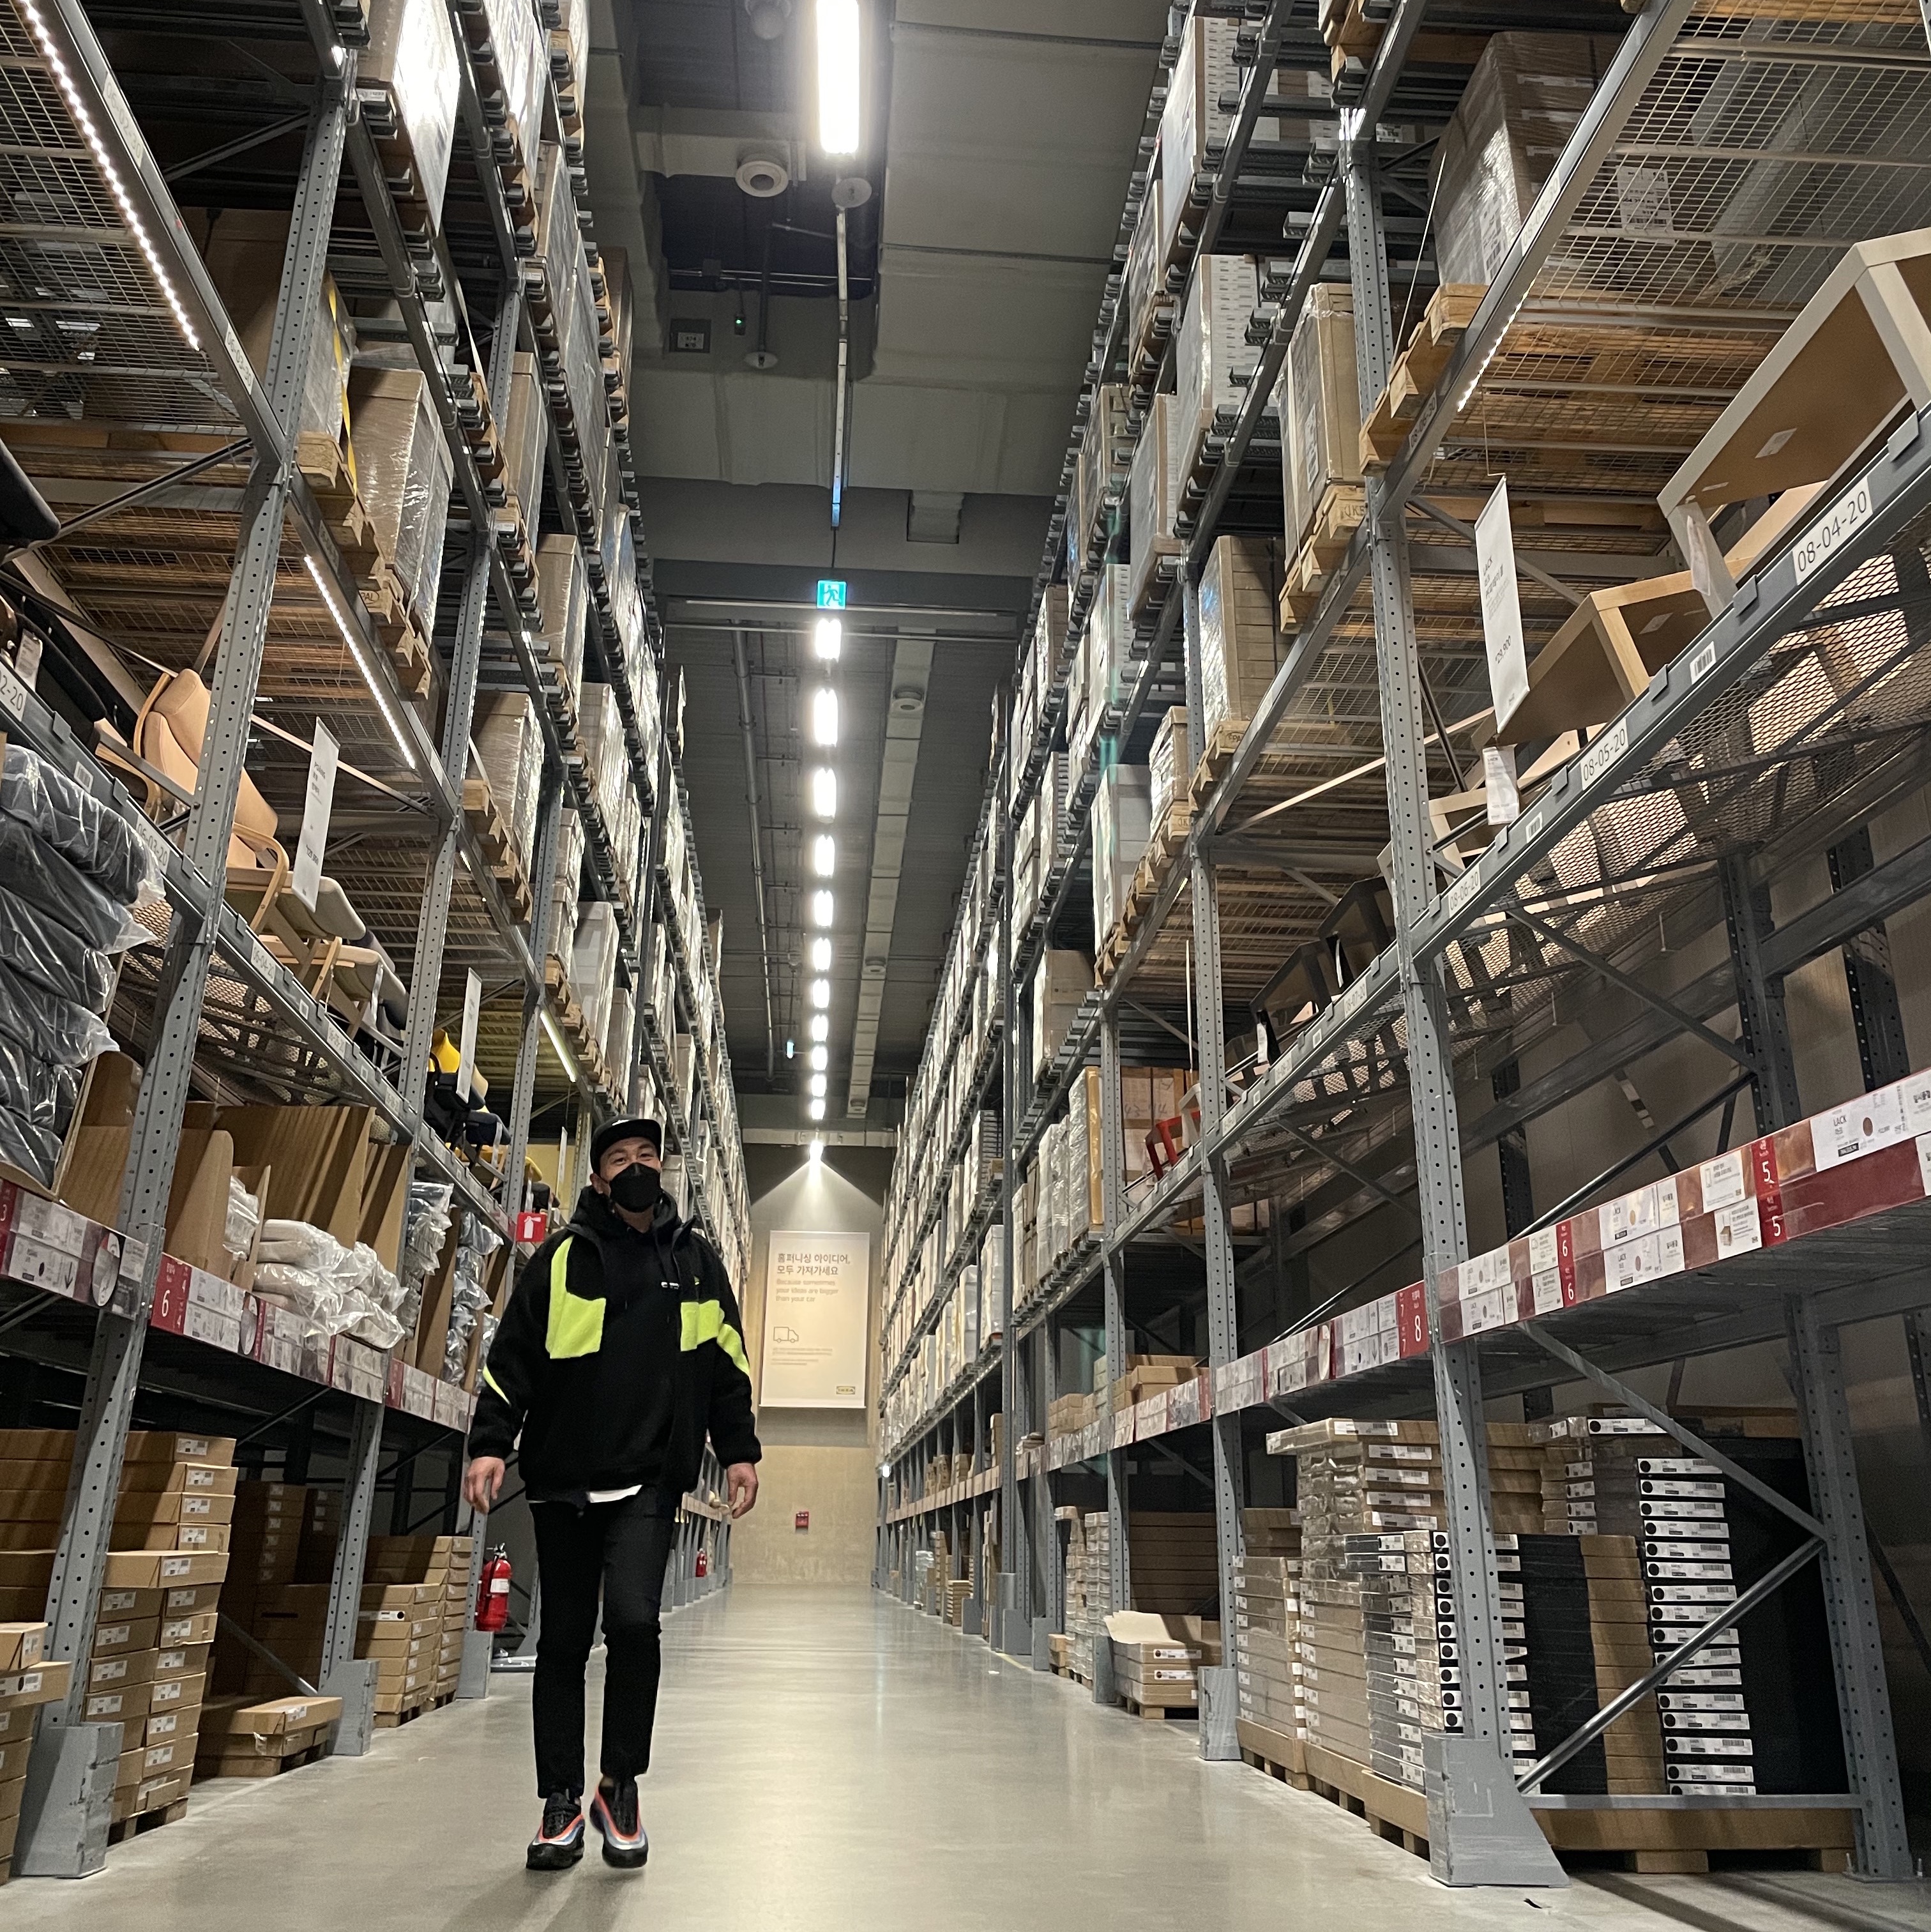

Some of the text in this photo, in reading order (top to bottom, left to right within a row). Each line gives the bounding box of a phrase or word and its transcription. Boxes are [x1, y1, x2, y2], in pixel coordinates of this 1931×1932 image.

[1798, 491, 1867, 572] 08-04-20
[0, 670, 24, 711] 2-20
[1583, 728, 1626, 781] 08-05-20
[1450, 871, 1479, 911] 08-06-20
[1833, 1114, 1847, 1127] LACK
[1762, 1160, 1771, 1182] 5
[1771, 1215, 1782, 1236] 5
[778, 1253, 851, 1264] 홈퍼니싱 아이디어,
[1562, 1240, 1568, 1257] 6
[776, 1265, 794, 1275] 모두
[1568, 1282, 1574, 1300] 6
[162, 1289, 170, 1318] 6
[1414, 1314, 1421, 1342] 8
